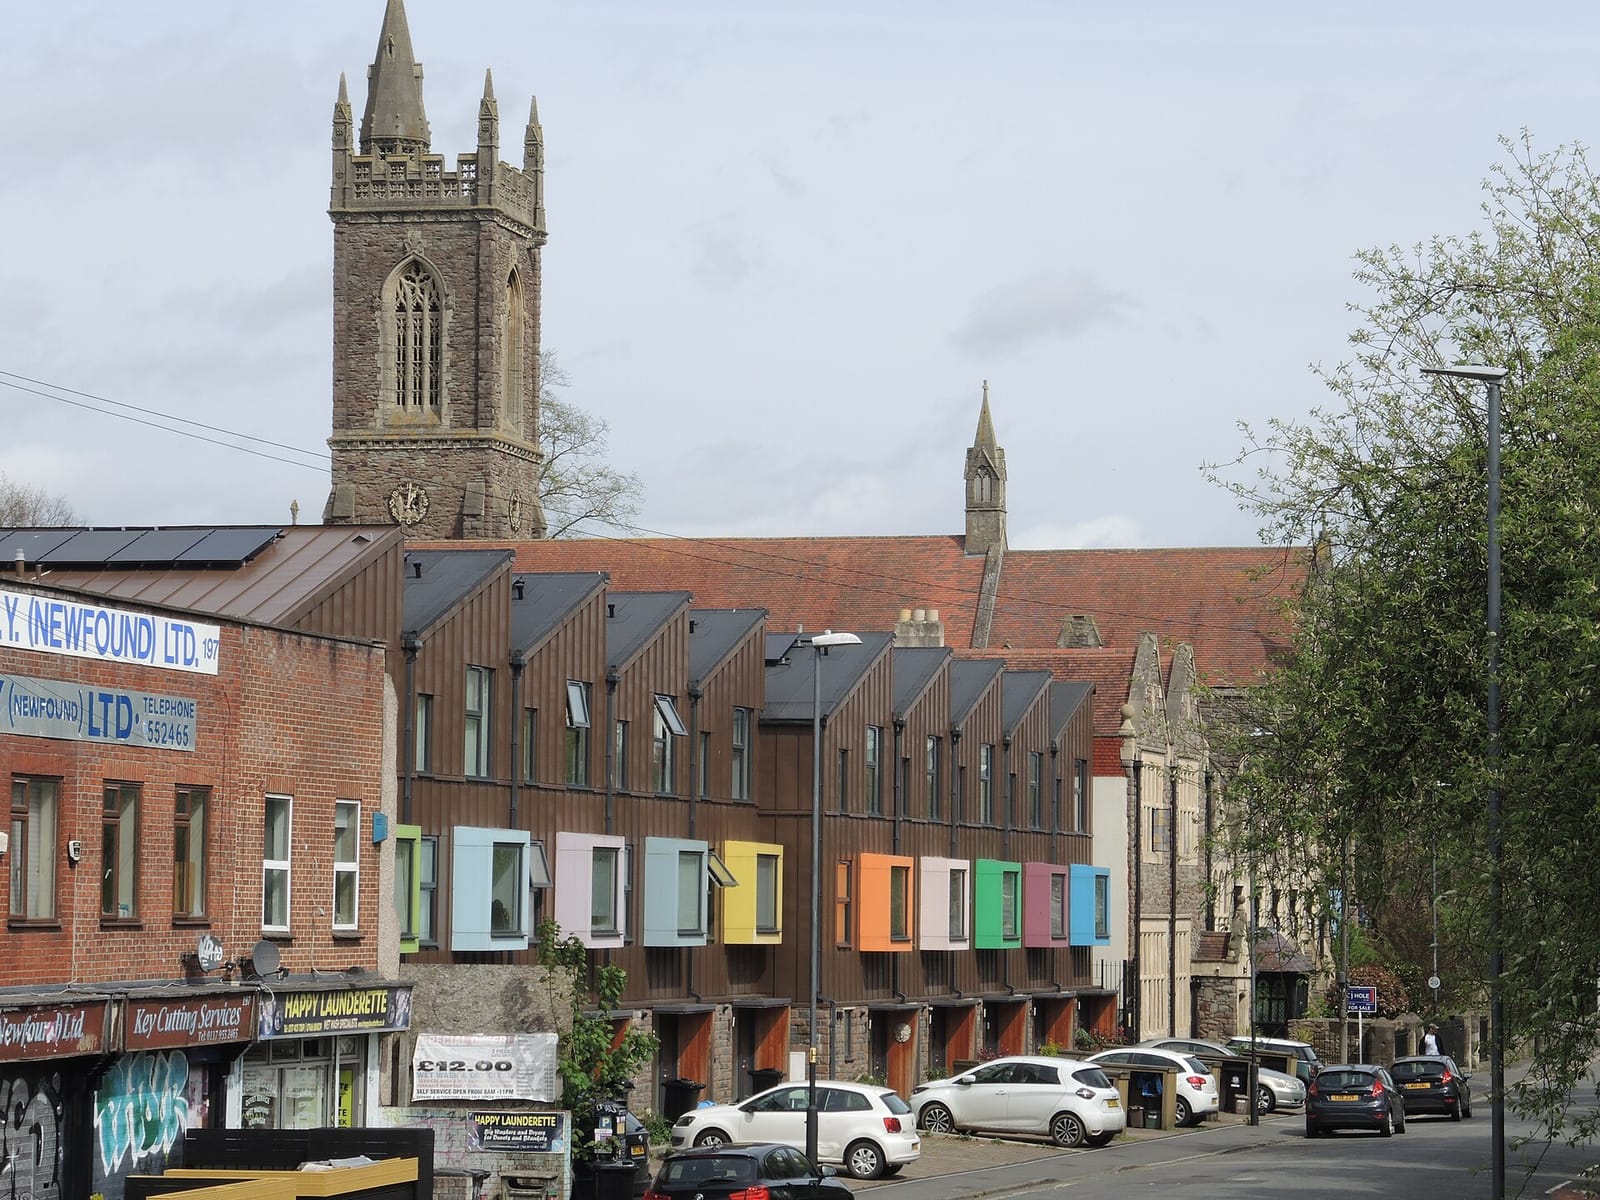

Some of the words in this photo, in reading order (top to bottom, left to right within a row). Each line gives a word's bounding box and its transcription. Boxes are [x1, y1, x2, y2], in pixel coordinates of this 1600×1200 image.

[28, 597, 156, 664] (NEWFOUND)
[164, 622, 199, 667] LTD.
[202, 638, 219, 660] 197
[9, 682, 83, 733] (NEWFOUND)
[143, 697, 195, 718] TELEPHONE
[147, 720, 189, 746] 552465
[284, 992, 320, 1018] HAPPY
[320, 990, 388, 1017] LAUNDERETTE
[133, 1009, 157, 1039] Key
[157, 1005, 198, 1036] Cutting
[197, 1001, 242, 1029] Services
[416, 1060, 513, 1072] £12.00
[474, 1115, 500, 1126] HAPPY
[501, 1115, 556, 1127] LAUNDERETTE
